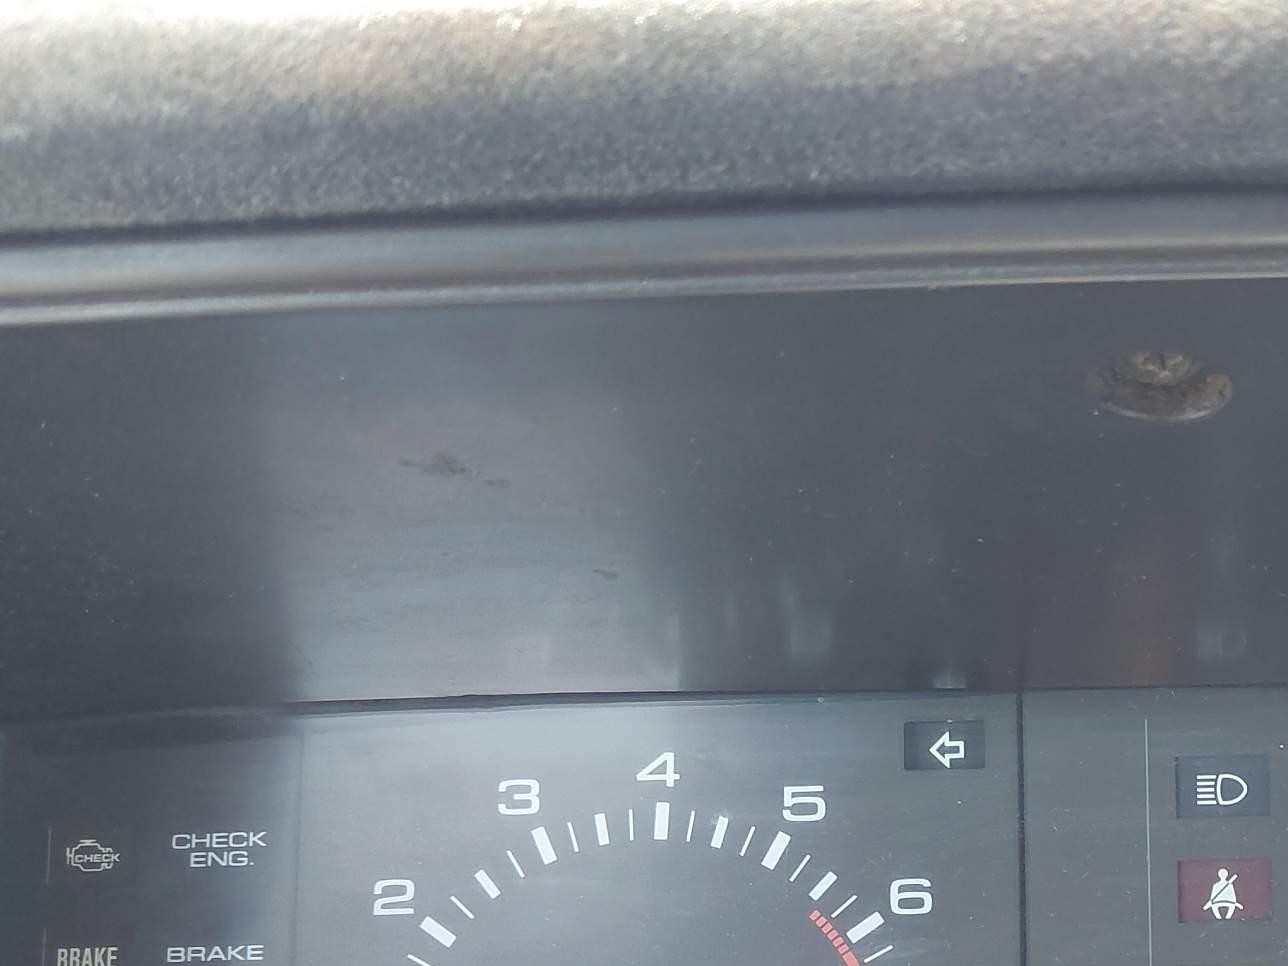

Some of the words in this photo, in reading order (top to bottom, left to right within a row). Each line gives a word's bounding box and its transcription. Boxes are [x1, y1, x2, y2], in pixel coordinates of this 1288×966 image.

[636, 752, 680, 787] 4
[498, 779, 540, 815] 3
[782, 785, 827, 822] 5
[75, 853, 121, 863] CHECK
[172, 832, 267, 849] CHECK
[190, 851, 255, 867] ENG.
[373, 879, 414, 915] 2
[890, 879, 933, 915] 6
[167, 945, 265, 962] BRAKE
